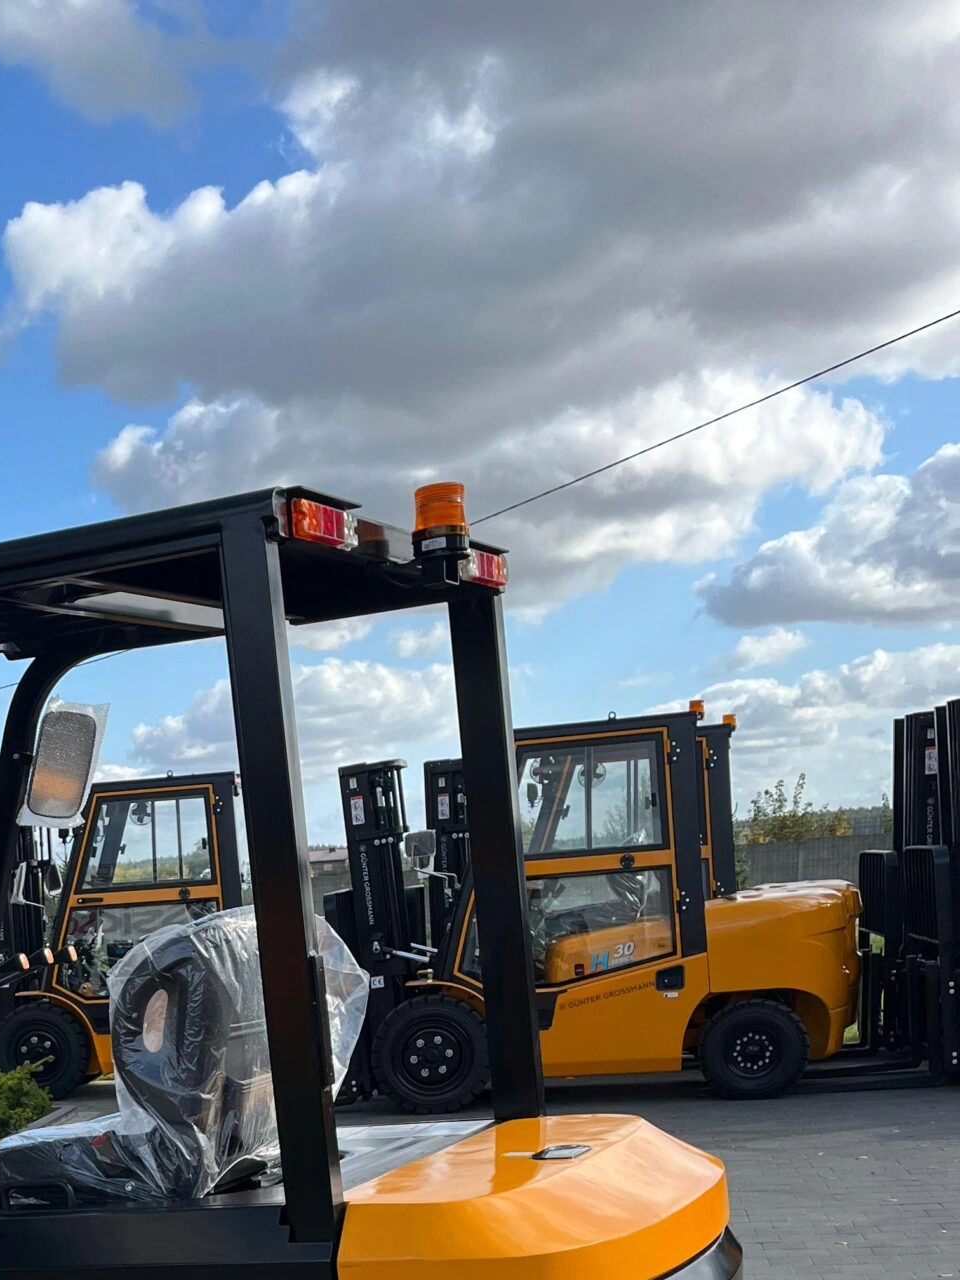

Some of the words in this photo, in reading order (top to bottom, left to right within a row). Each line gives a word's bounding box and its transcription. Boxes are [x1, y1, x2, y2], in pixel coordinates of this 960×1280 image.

[363, 883, 375, 925] GROSSMANN
[591, 950, 610, 972] H
[614, 942, 635, 958] 30
[603, 982, 655, 999] GROSSMANN
